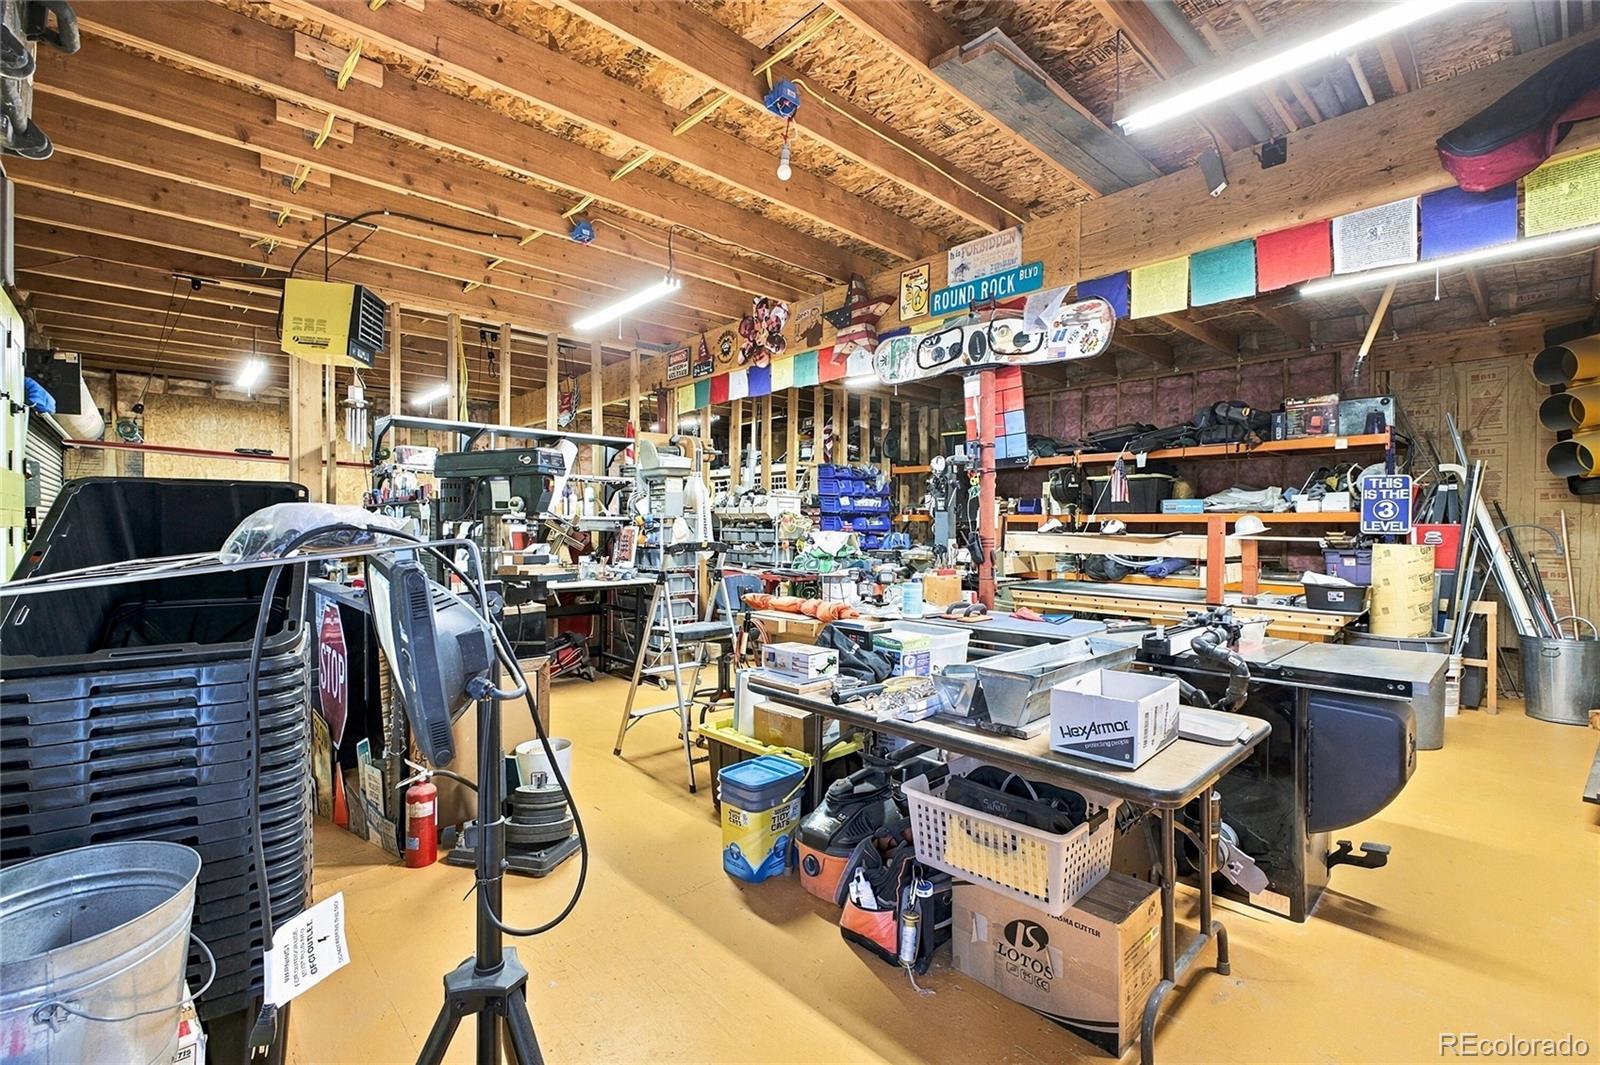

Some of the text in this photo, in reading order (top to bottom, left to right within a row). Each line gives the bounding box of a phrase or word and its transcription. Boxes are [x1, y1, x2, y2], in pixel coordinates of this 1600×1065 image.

[961, 230, 1016, 258] FORBIDDEN
[933, 284, 976, 312] ROUND
[981, 273, 1016, 300] ROCK
[1019, 265, 1039, 281] BLVD
[1369, 478, 1403, 489] THIS
[1364, 489, 1409, 500] IS THE
[1378, 501, 1394, 518] 3
[1363, 521, 1408, 531] LEVEL
[320, 642, 345, 704] STOP
[1059, 720, 1129, 740] HexArmor
[770, 820, 790, 831] CATS
[772, 811, 790, 824] TIDY
[1074, 922, 1101, 938] CUTTER
[997, 942, 1054, 980] LOTOS
